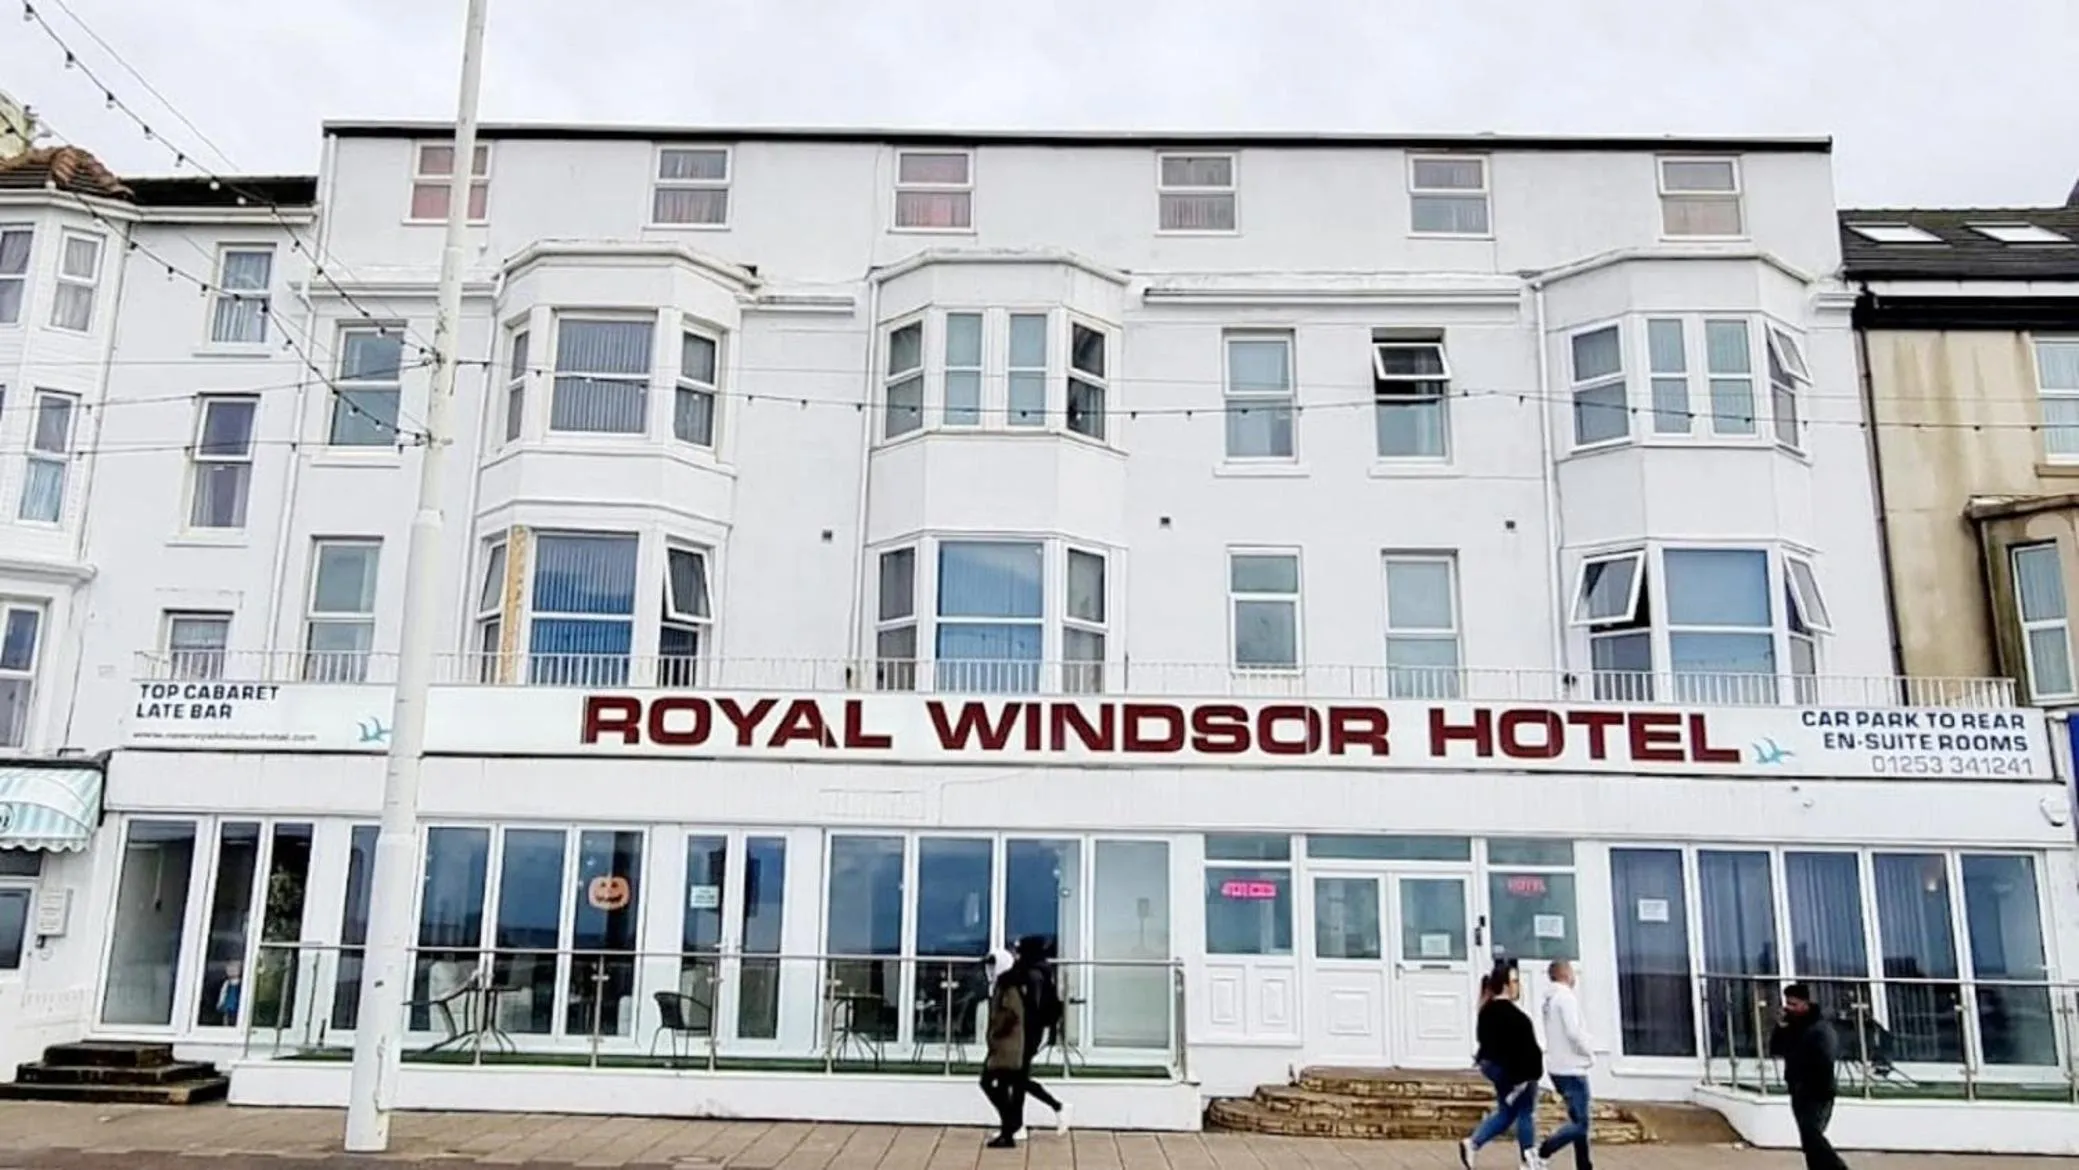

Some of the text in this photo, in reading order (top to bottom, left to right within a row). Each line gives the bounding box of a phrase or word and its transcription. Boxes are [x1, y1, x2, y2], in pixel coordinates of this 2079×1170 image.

[140, 684, 280, 700] TOP CABARET
[136, 703, 232, 719] LATE BAR
[1801, 710, 2026, 730] CAR PARK TO REAR
[581, 695, 1741, 764] ROYAL WINDSOR HOTEL
[1823, 732, 2029, 752] EN-SUITE ROOMS
[1872, 755, 2033, 776] 01253 341241
